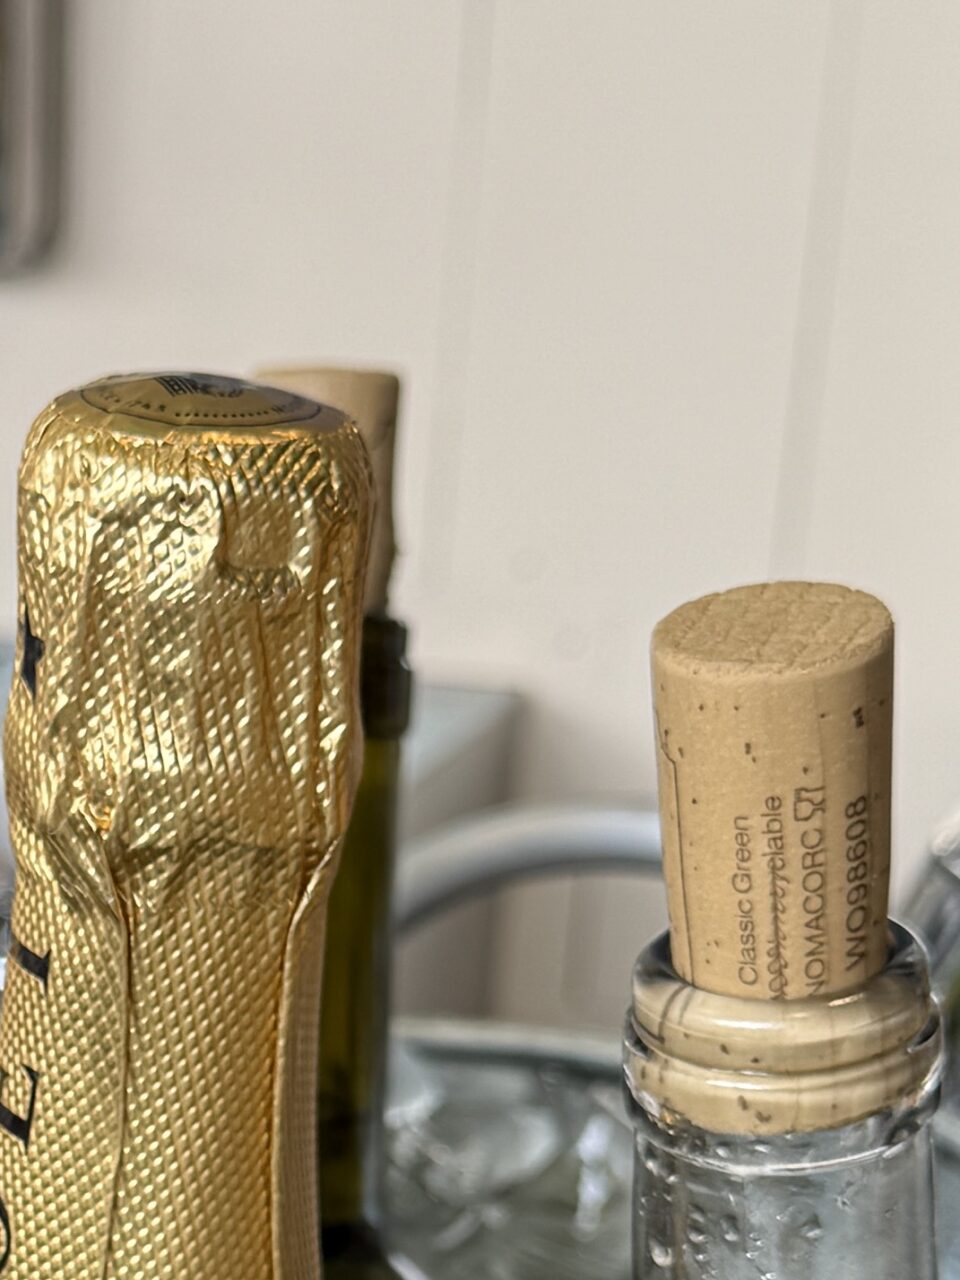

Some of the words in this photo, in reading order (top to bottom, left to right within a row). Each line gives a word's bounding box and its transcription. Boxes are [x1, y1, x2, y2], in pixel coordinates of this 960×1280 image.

[731, 815, 751, 894] Green
[735, 898, 758, 986] Classic
[800, 828, 828, 998] NOMACORC
